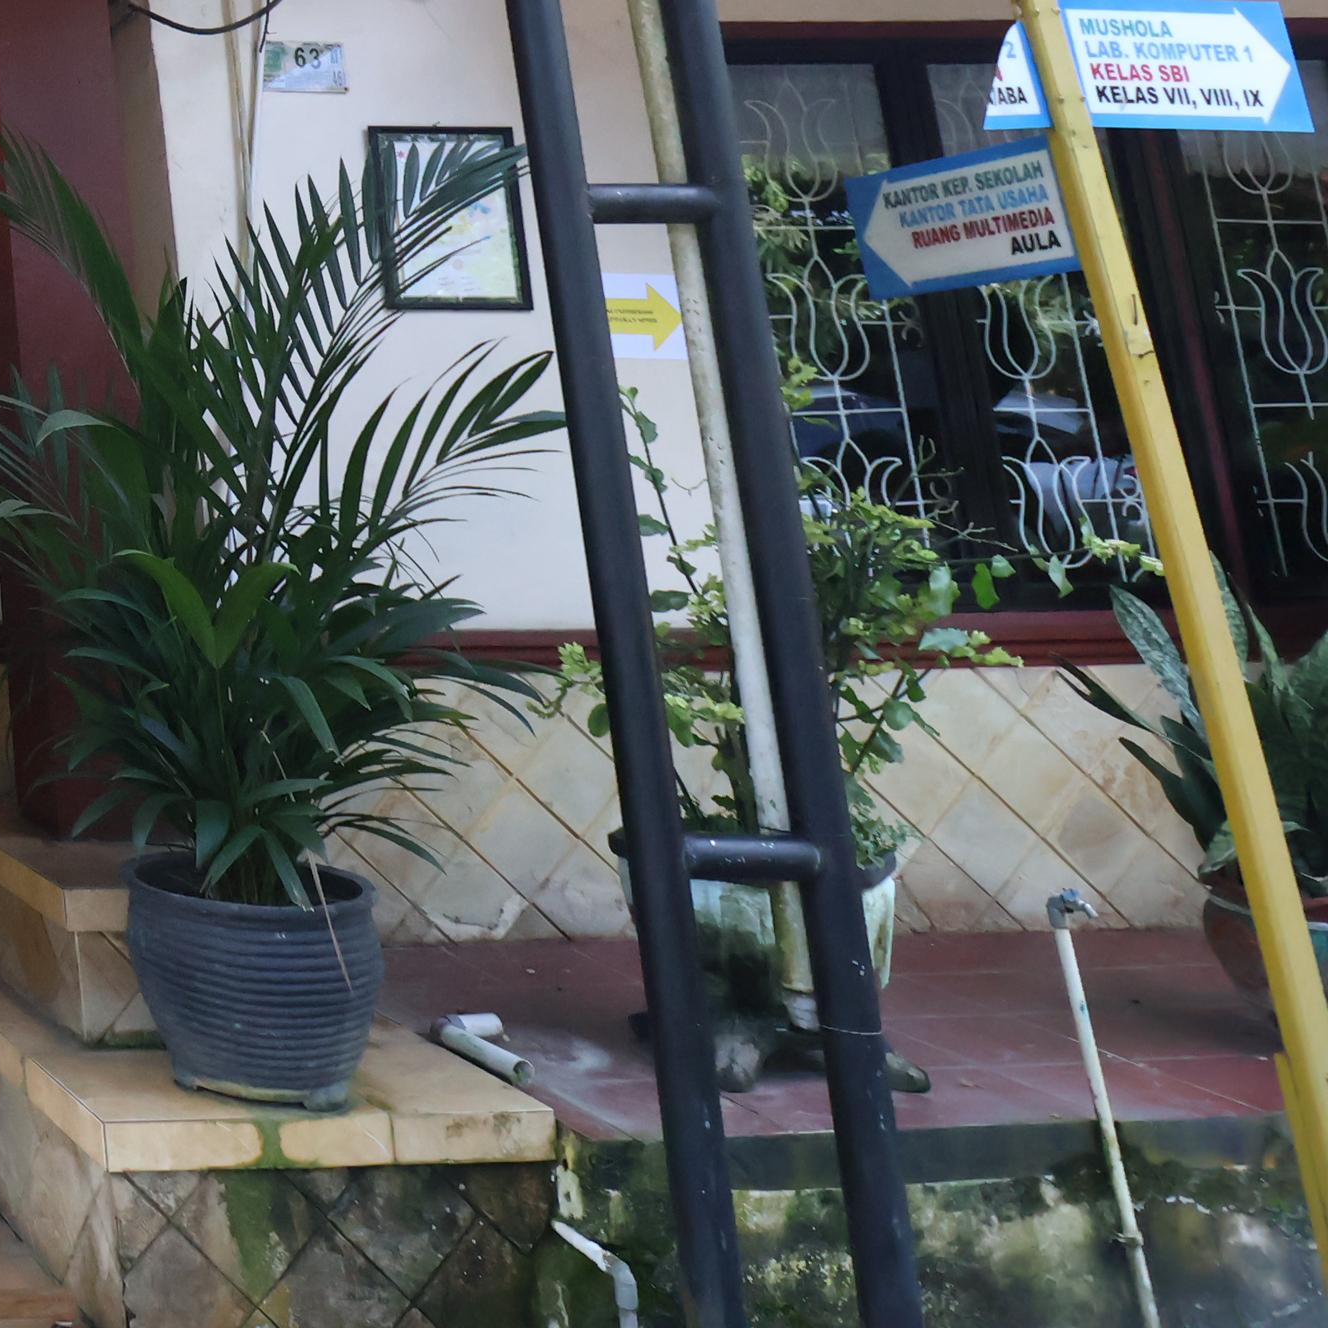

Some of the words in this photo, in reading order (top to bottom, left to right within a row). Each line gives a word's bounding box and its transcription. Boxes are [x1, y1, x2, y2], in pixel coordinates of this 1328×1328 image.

[1079, 18, 1174, 38] MUSHOLA
[294, 47, 322, 69] 63
[1084, 40, 1129, 59] LAB.
[1133, 42, 1240, 62] KOMPUTER
[1244, 45, 1254, 63] 1
[1090, 63, 1153, 82] KELAS
[1160, 64, 1191, 83] SBI
[1095, 85, 1160, 105] KELAS
[1163, 87, 1198, 110] VII,
[1200, 88, 1240, 111] VIII,
[1244, 89, 1264, 108] IX
[882, 182, 940, 209] KANTOR
[974, 160, 1044, 190] SEKOLAH
[899, 202, 956, 229] KANTOR
[958, 195, 995, 218] TATA
[998, 183, 1049, 210] USAHA
[911, 225, 961, 249] RUANG
[963, 206, 1056, 241] MULTIMEDIA
[1010, 229, 1062, 255] AULA
